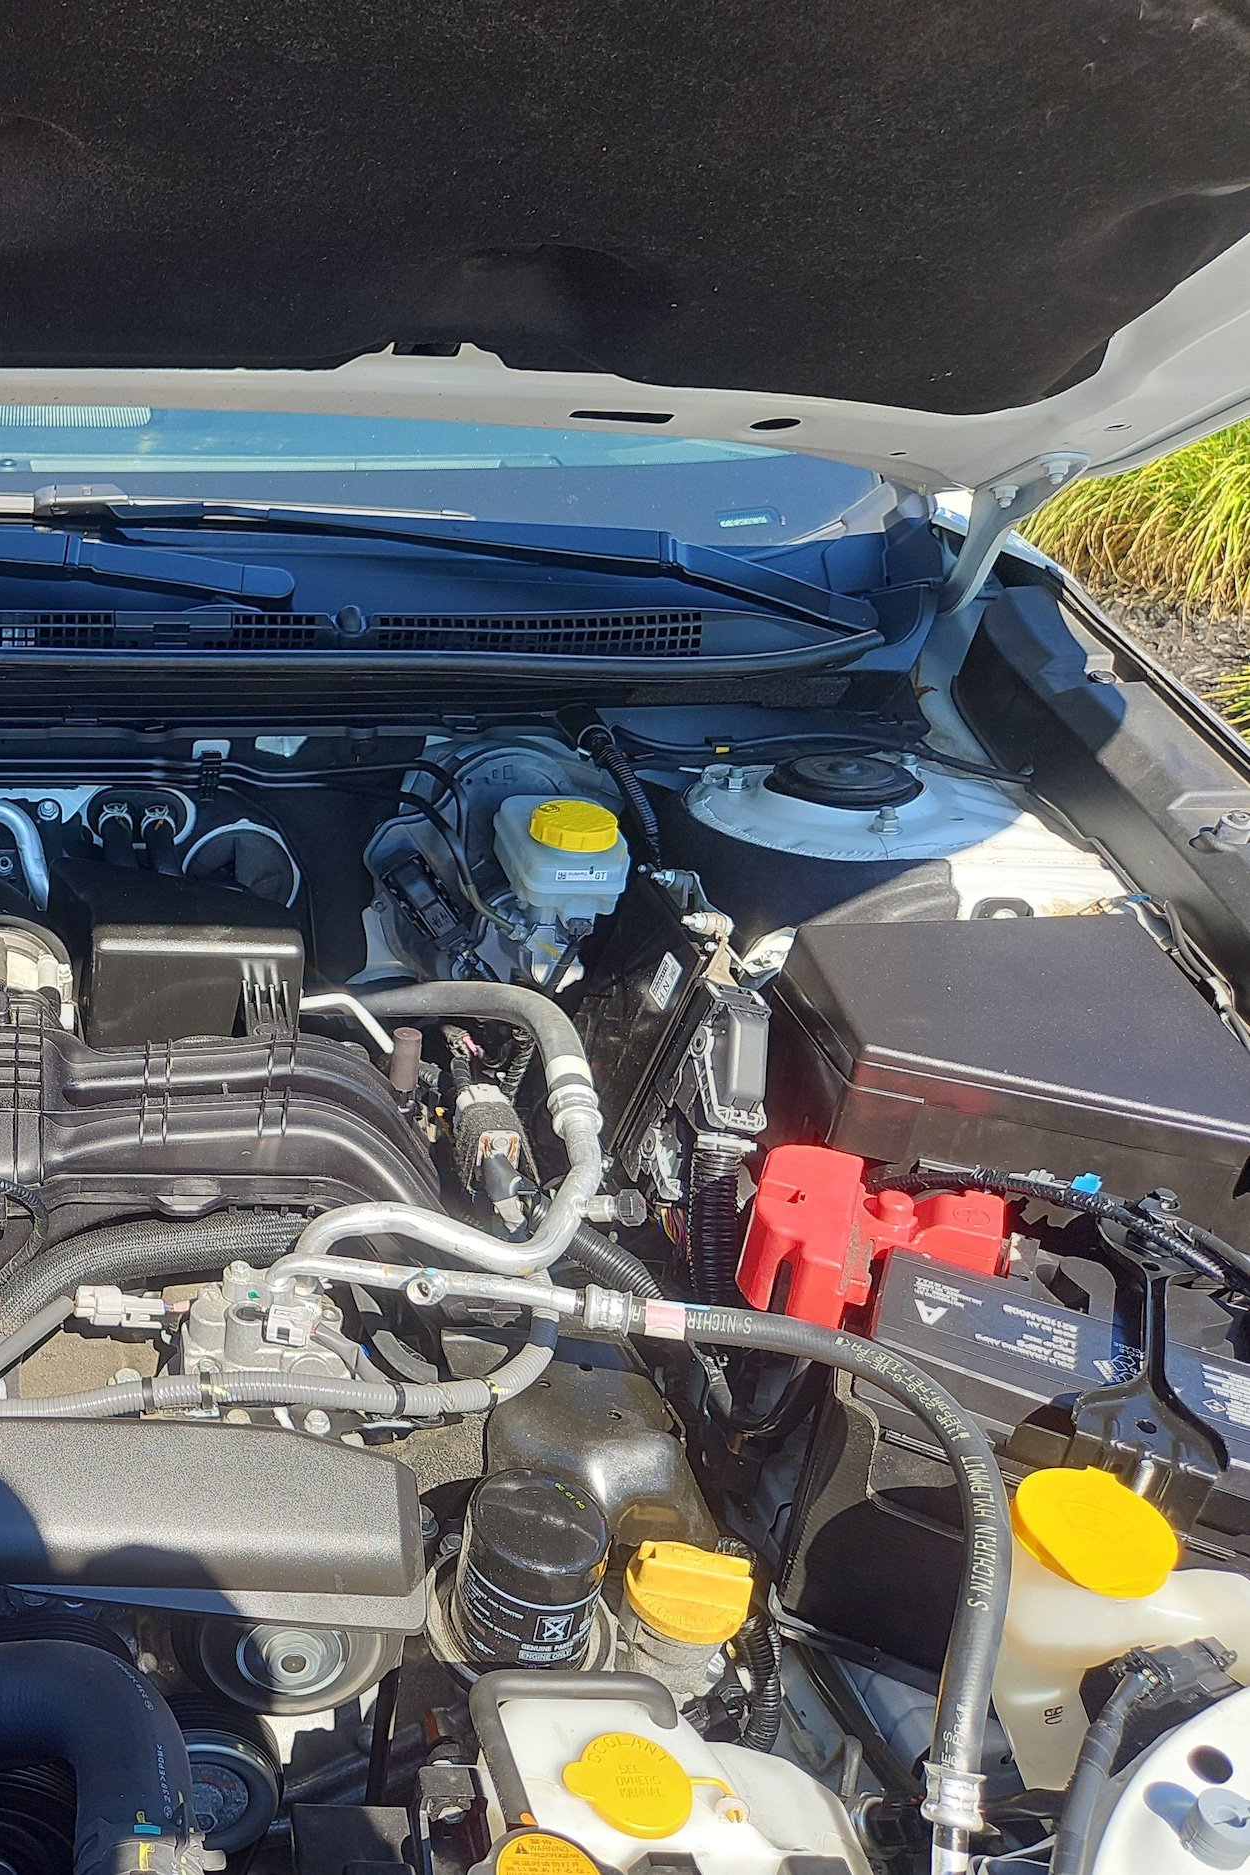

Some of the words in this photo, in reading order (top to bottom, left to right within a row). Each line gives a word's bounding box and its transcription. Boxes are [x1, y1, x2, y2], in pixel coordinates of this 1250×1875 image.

[960, 1455, 996, 1519] HYLAMMIT
[521, 1643, 552, 1652] GENUINE
[587, 1735, 668, 1763] COOLANT
